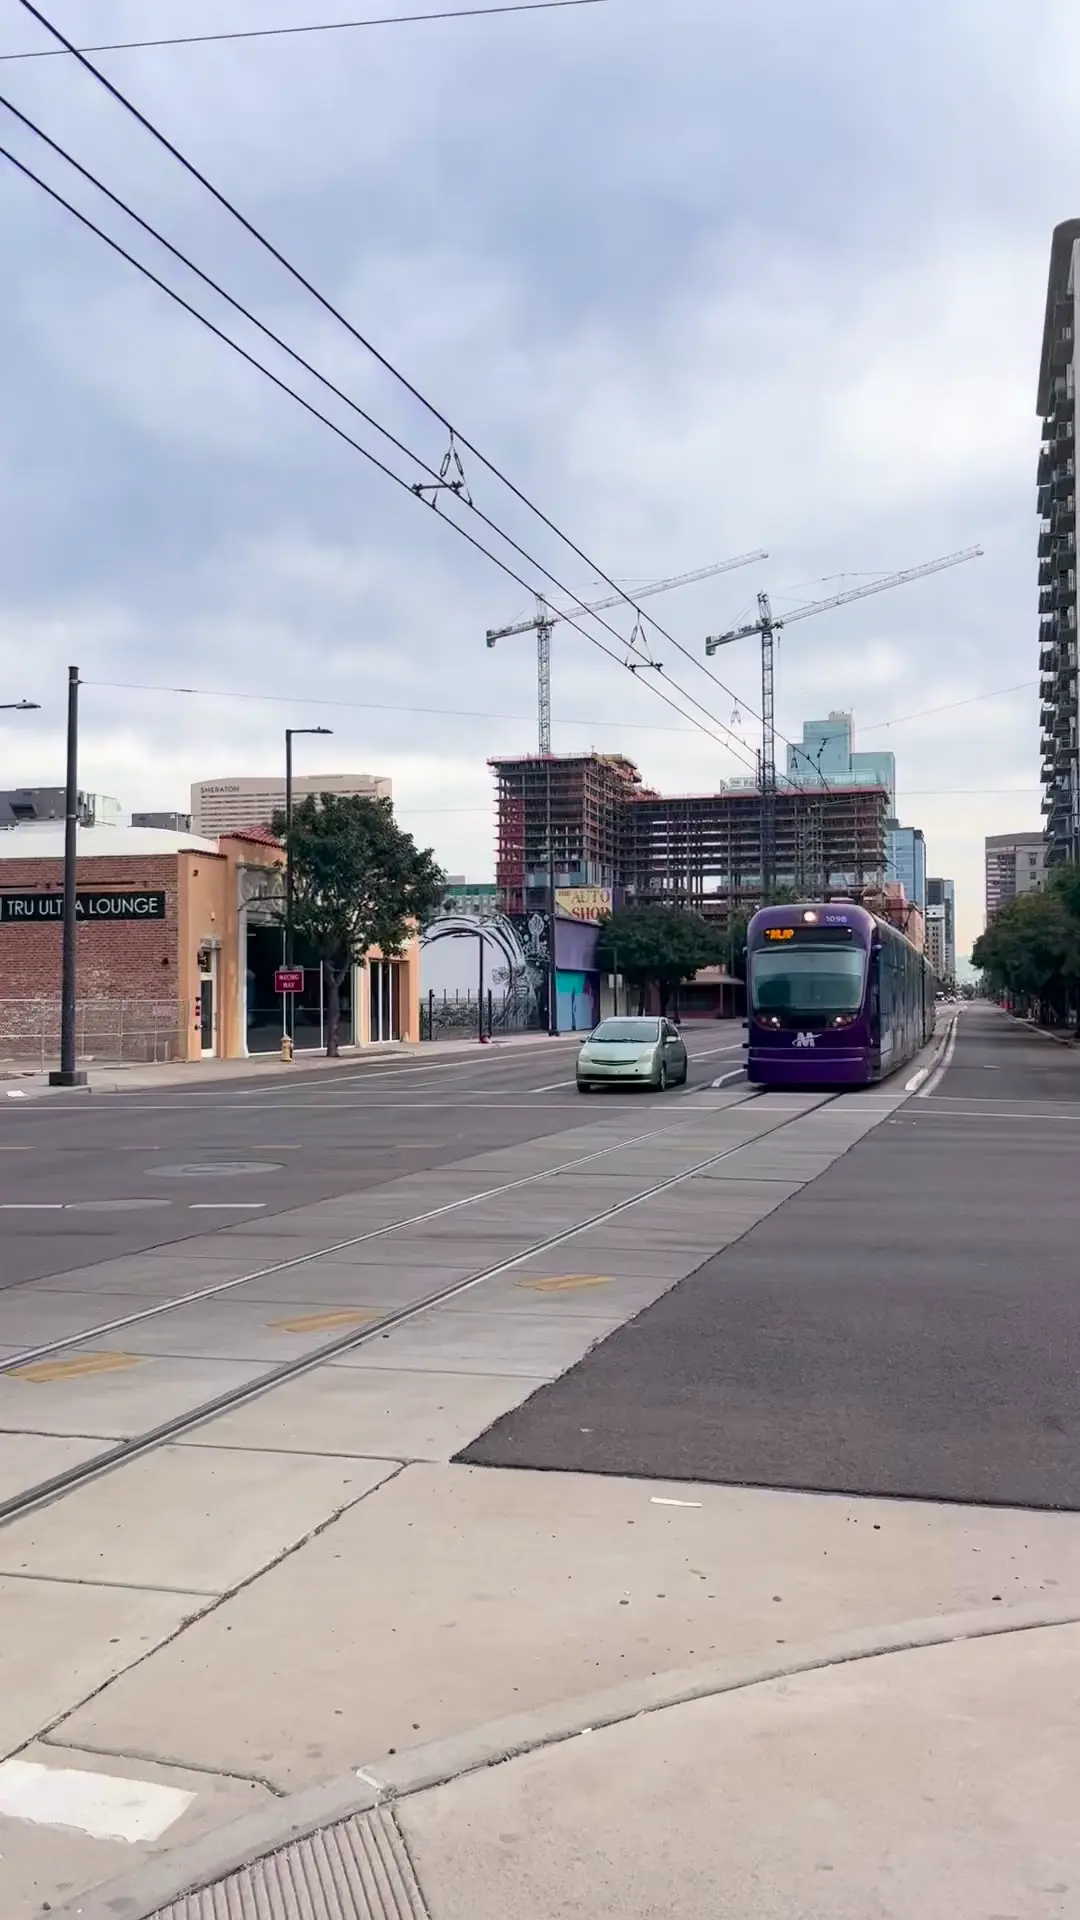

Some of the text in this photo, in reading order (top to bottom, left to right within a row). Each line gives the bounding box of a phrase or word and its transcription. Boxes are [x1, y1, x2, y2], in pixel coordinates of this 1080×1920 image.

[571, 890, 609, 903] AUTO
[7, 898, 158, 915] TRU ULTA LOUNGE
[572, 907, 610, 920] SHOP
